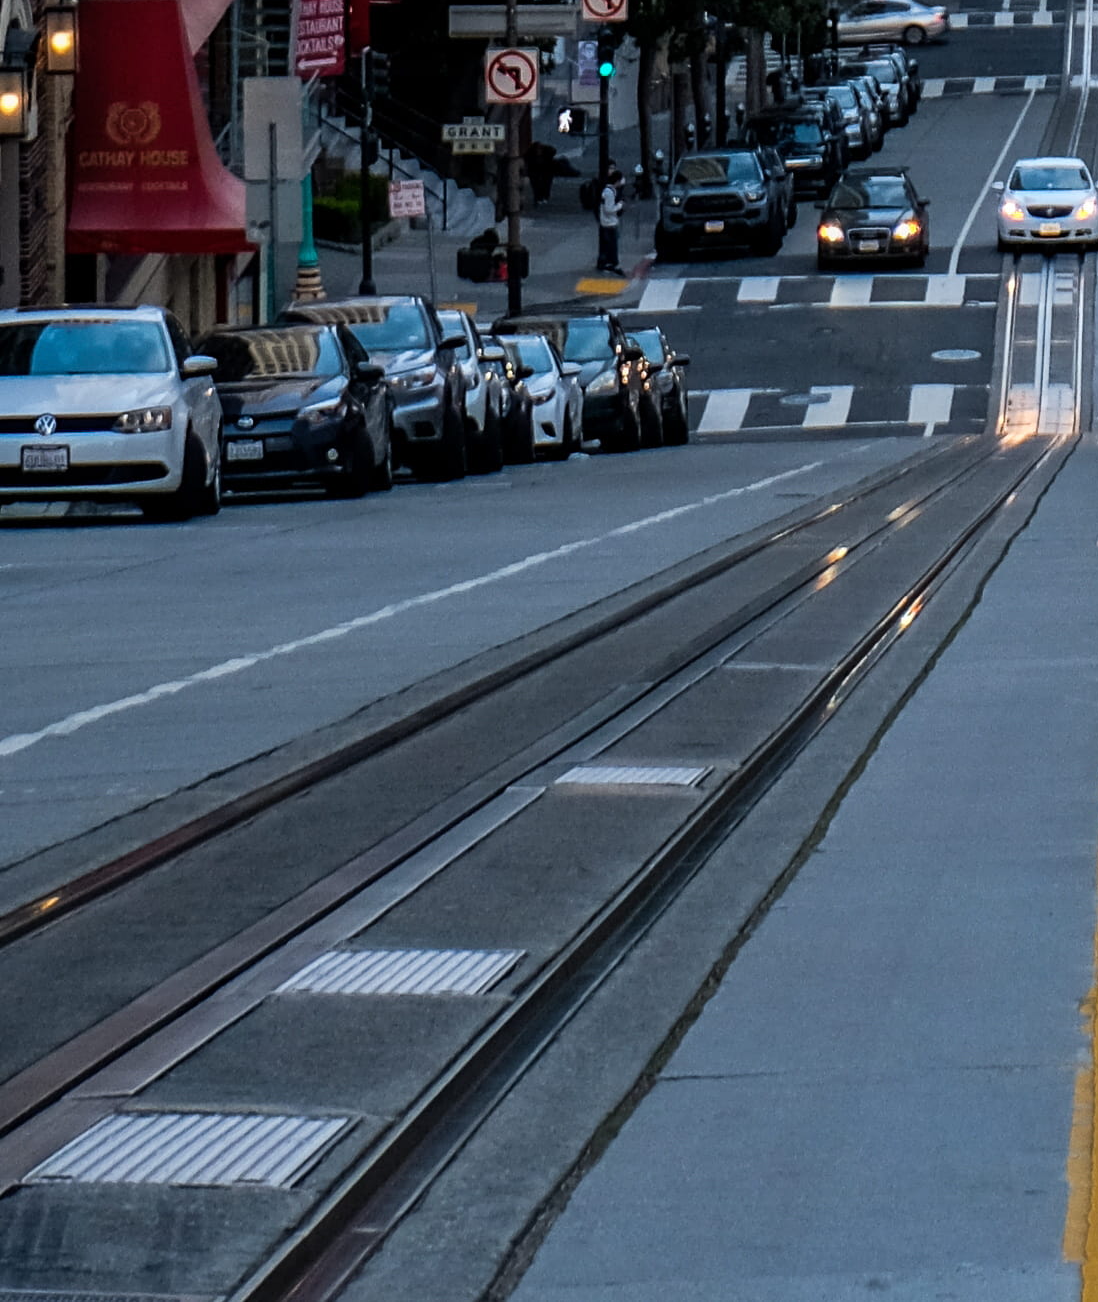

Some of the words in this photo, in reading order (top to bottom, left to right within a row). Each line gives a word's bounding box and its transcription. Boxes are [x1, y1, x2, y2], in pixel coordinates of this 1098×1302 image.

[447, 126, 501, 137] GRANT
[79, 150, 135, 167] CATHAY
[140, 149, 189, 165] HOUSE
